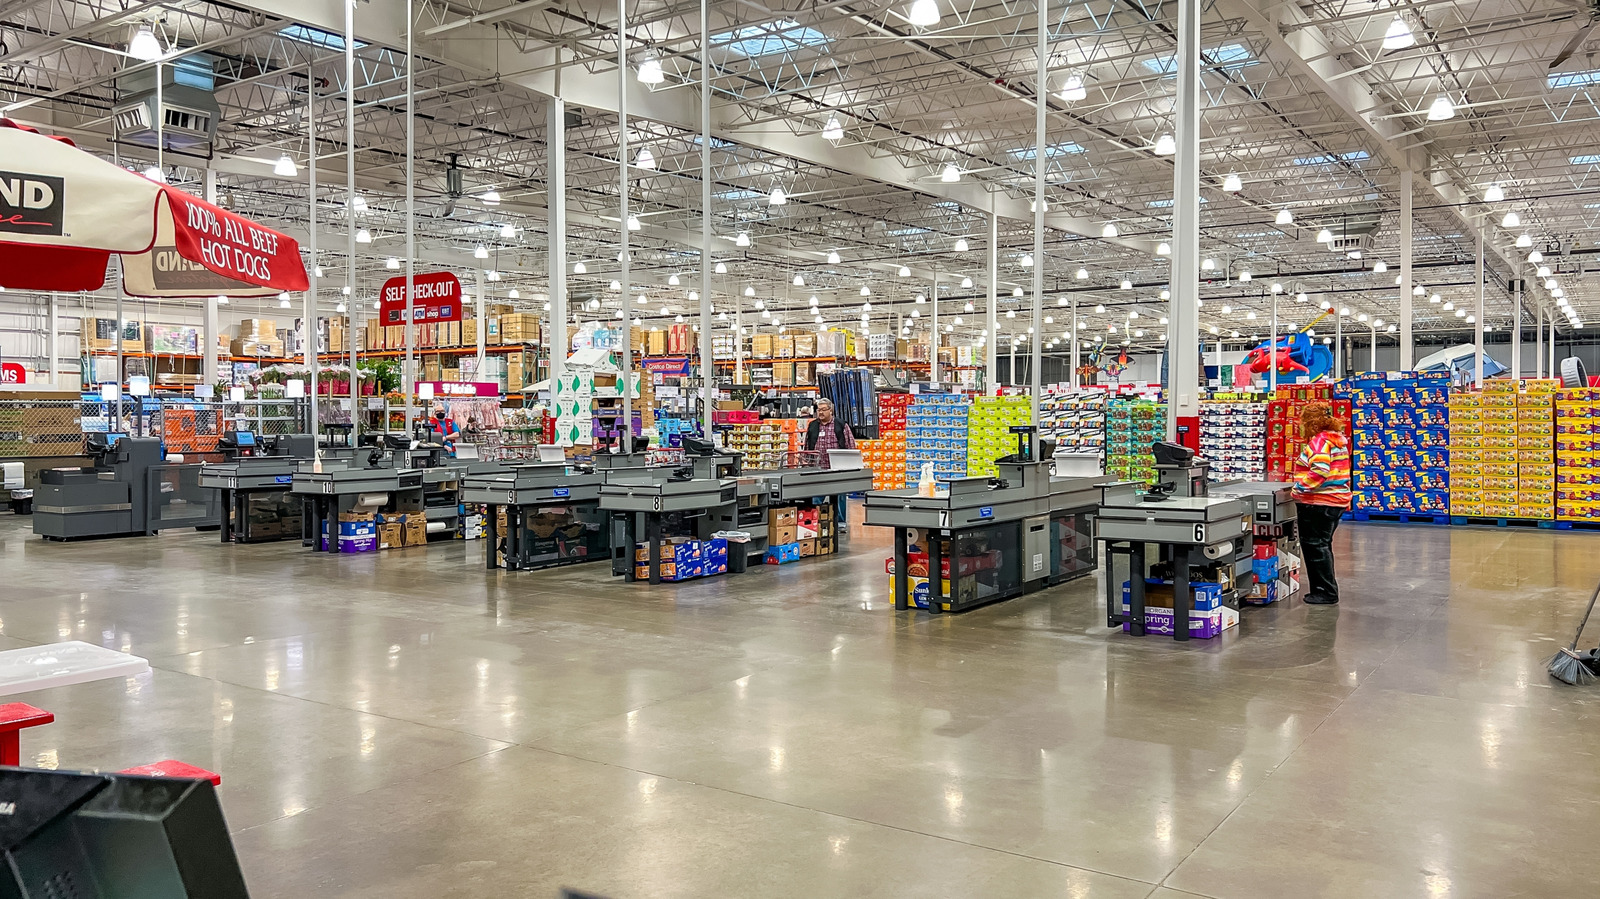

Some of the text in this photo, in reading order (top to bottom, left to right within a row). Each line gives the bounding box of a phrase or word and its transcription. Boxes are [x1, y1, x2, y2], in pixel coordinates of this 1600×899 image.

[186, 201, 278, 256] 100% ALL BEEF
[200, 237, 271, 281] HOT DOGS
[386, 281, 454, 302] SELF HECK-OUT
[229, 477, 236, 488] 11
[323, 482, 332, 493] 10
[508, 490, 513, 503] 9
[654, 496, 659, 510] 8
[940, 511, 947, 526] 7
[1195, 523, 1203, 541] 6
[1145, 615, 1170, 626] pring
